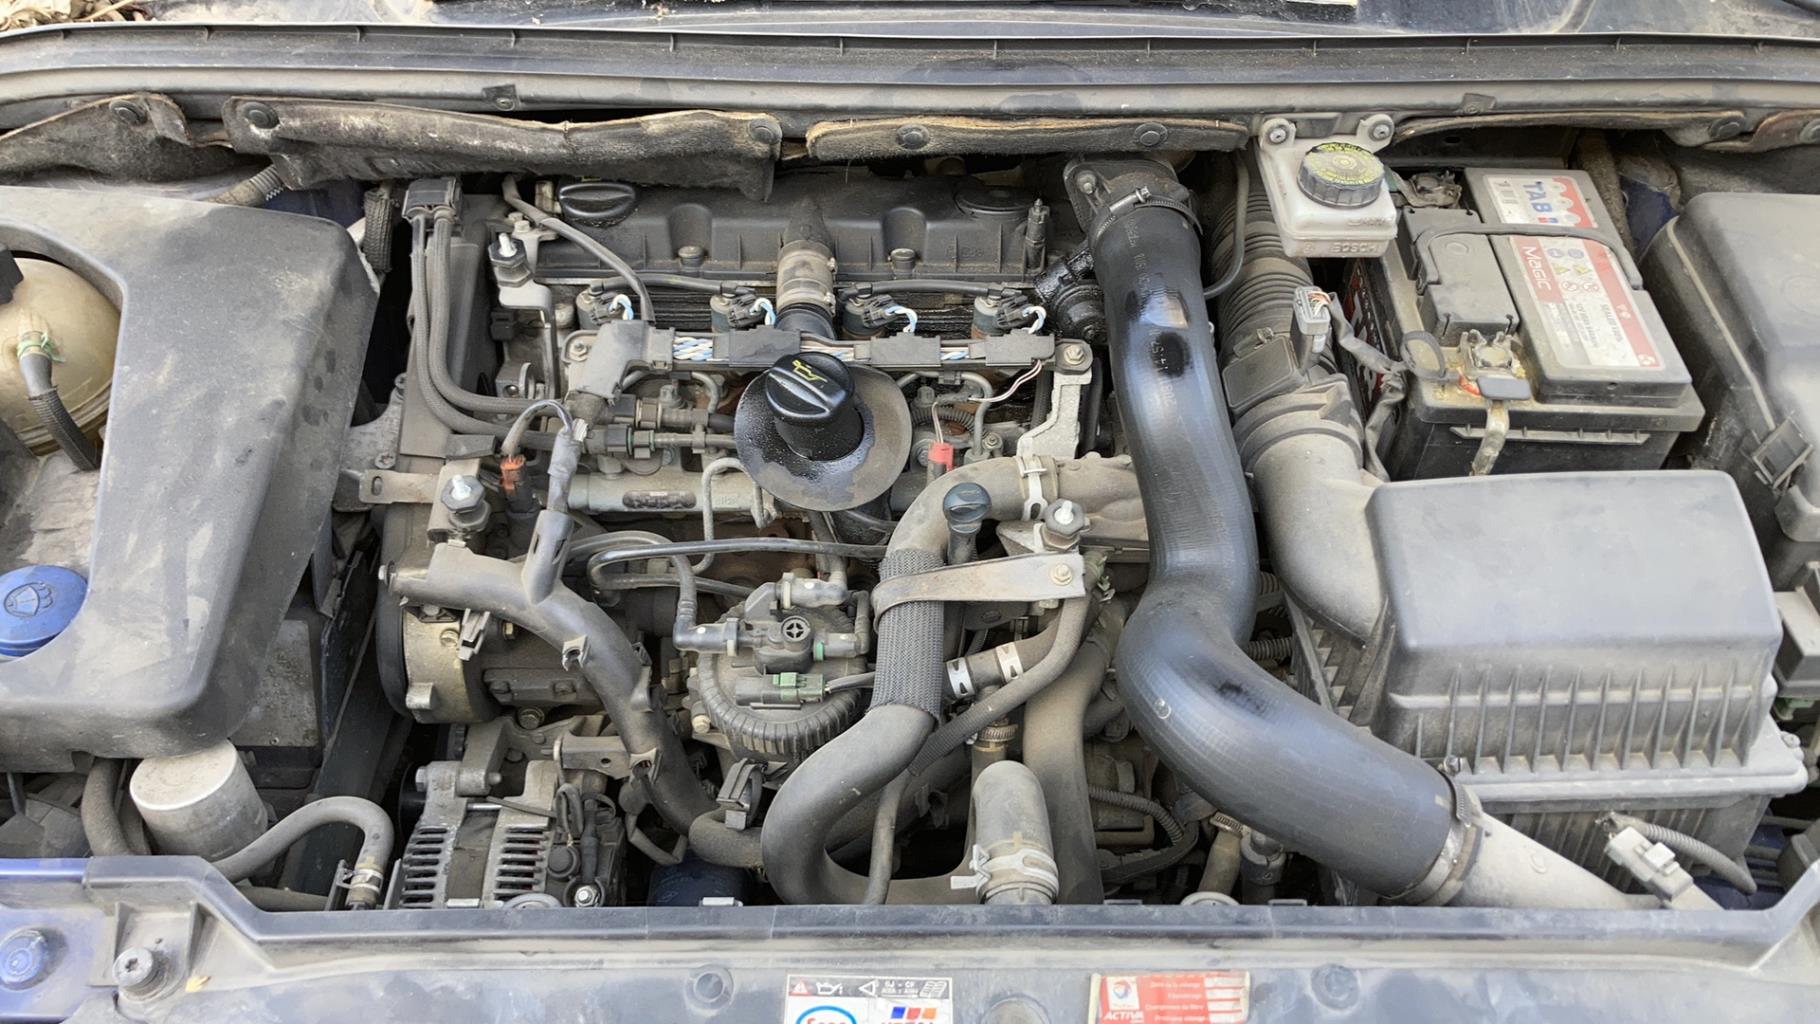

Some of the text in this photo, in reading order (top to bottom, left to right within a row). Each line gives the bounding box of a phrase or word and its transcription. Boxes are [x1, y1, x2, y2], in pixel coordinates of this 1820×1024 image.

[1523, 181, 1552, 212] TAB
[1330, 242, 1378, 253] BOSCH
[1104, 1011, 1144, 1021] ACTIVA
